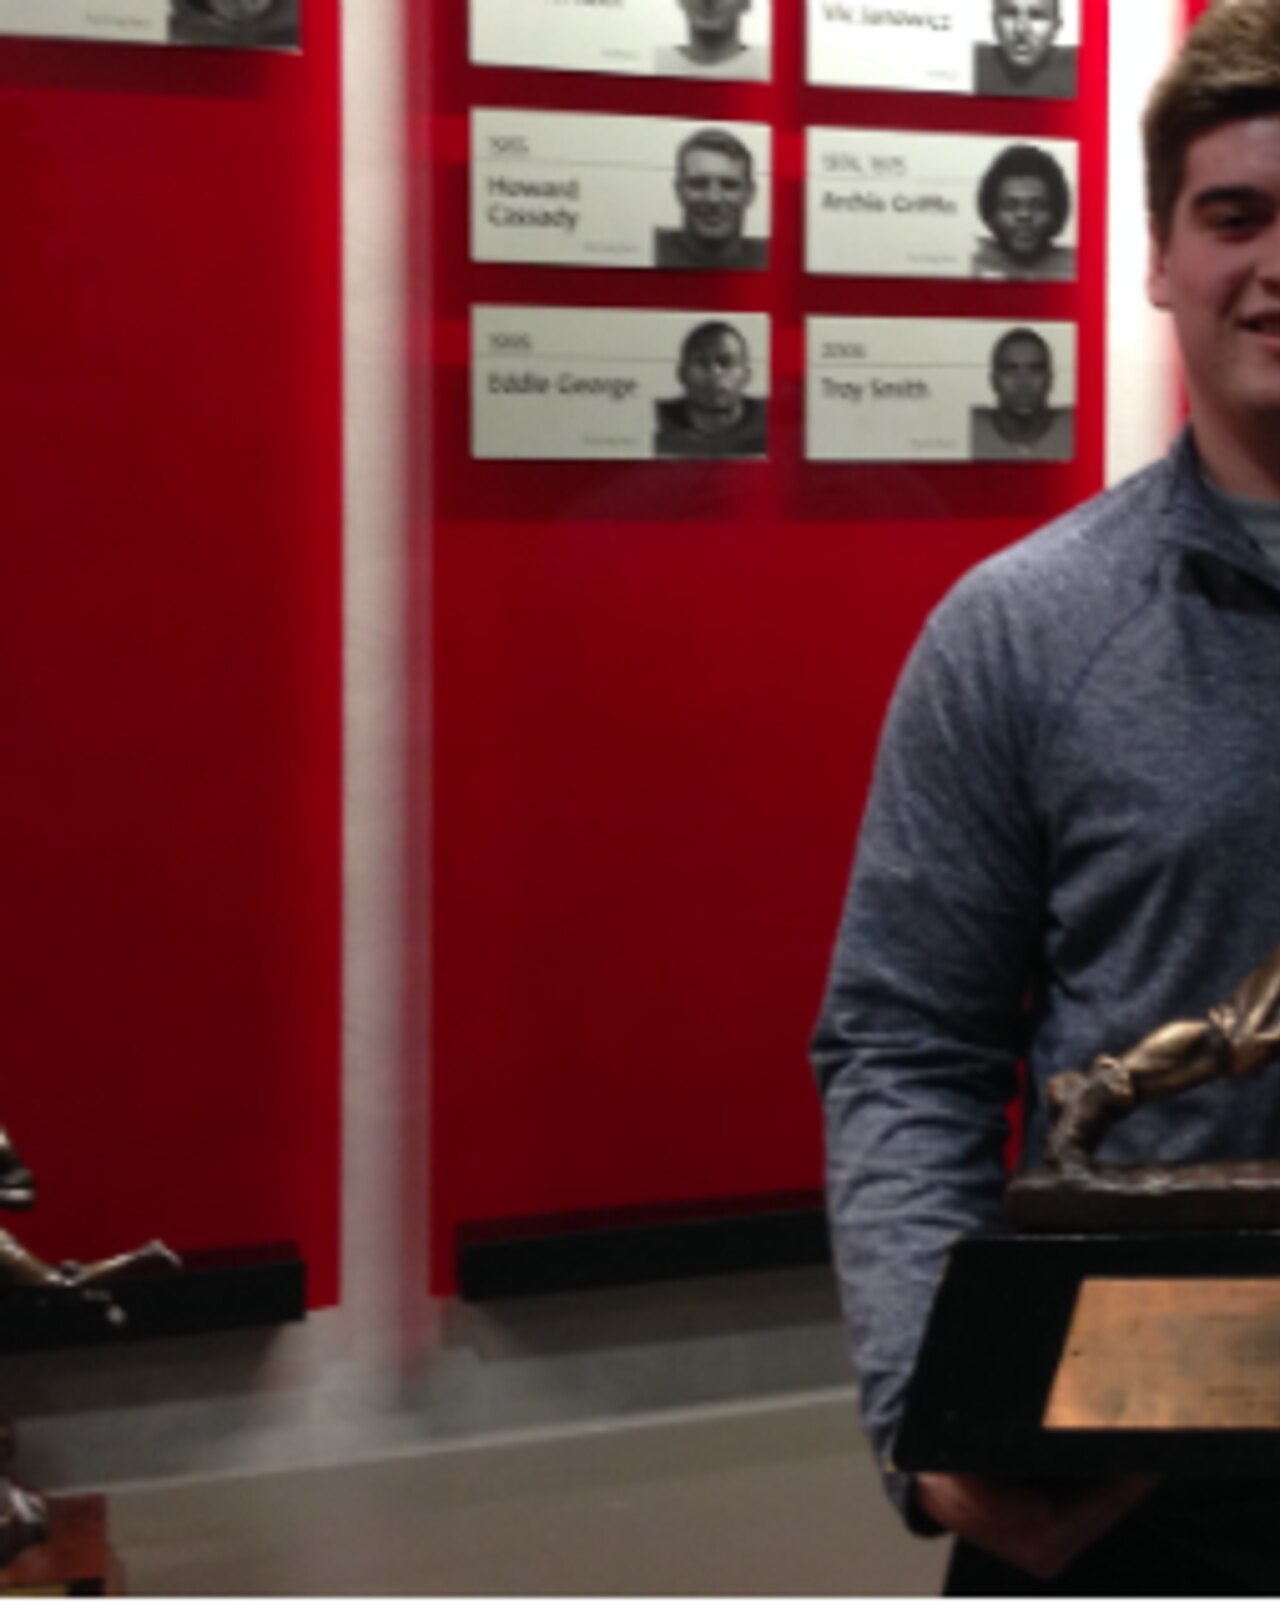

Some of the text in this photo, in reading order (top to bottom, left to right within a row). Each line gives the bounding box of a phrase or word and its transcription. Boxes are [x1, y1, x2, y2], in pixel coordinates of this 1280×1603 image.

[487, 175, 580, 200] Howard
[487, 203, 580, 234] Cassady
[488, 371, 637, 402] Eddie George
[821, 376, 932, 403] Troy Smith
